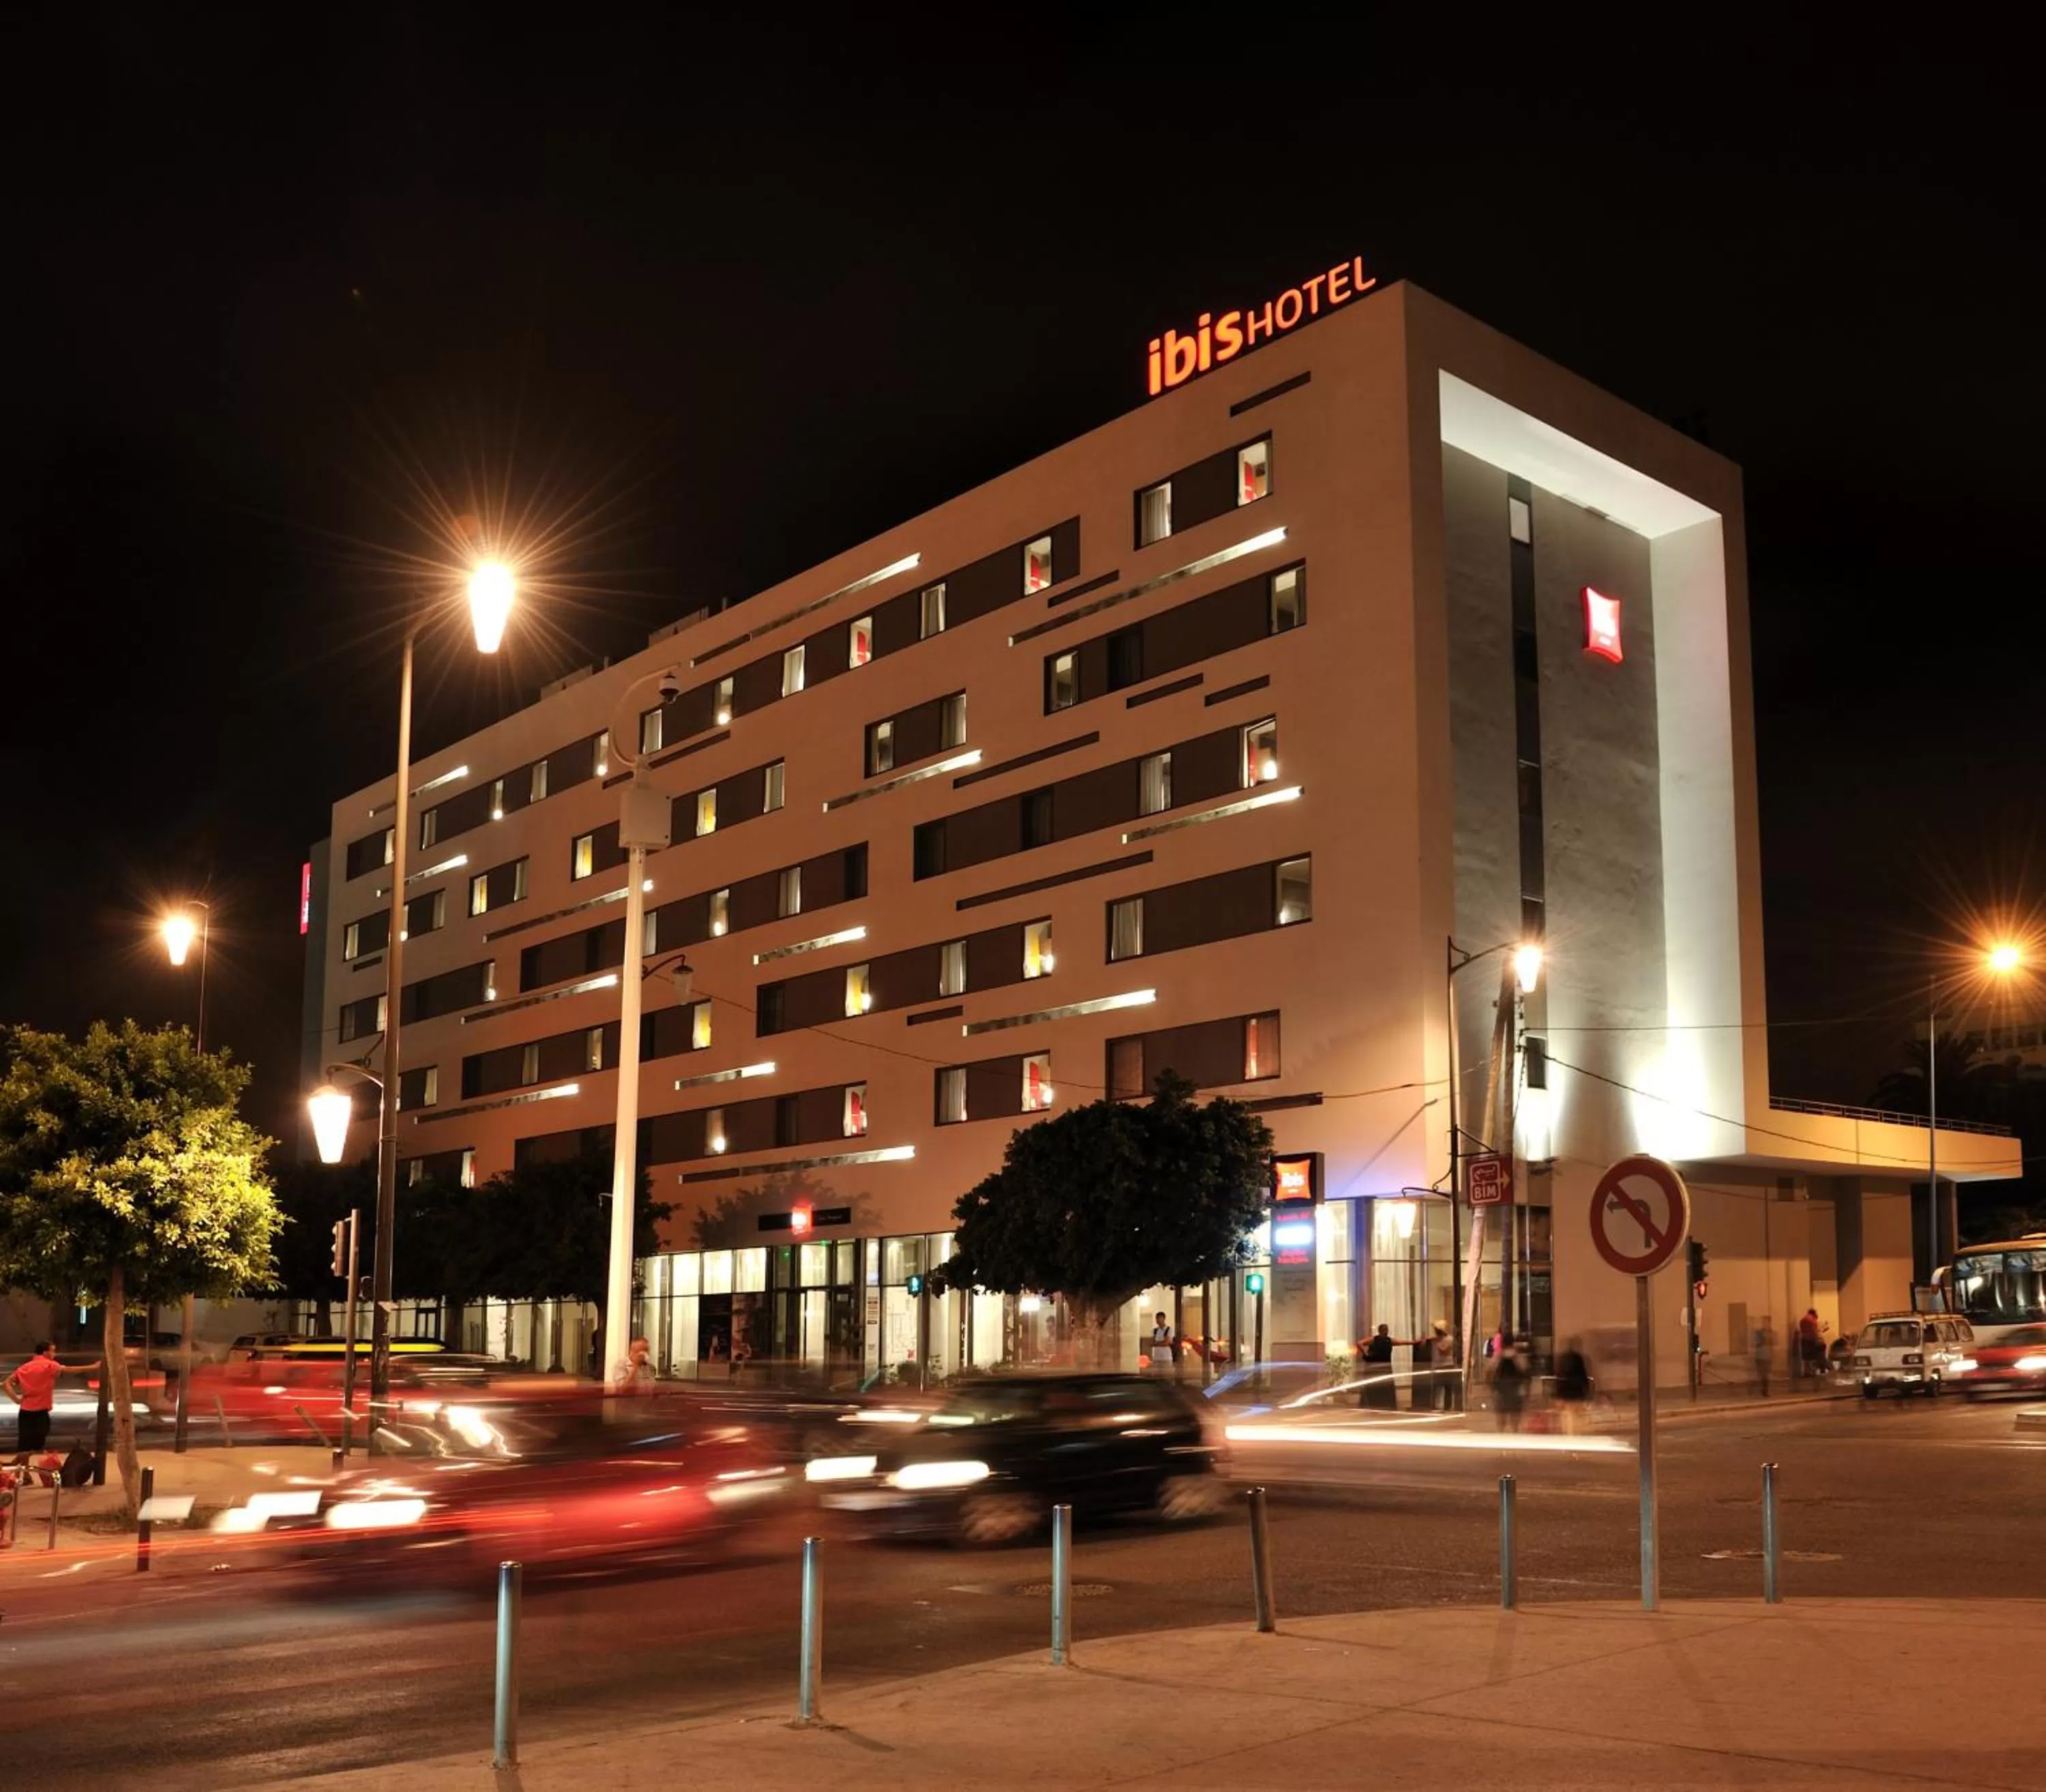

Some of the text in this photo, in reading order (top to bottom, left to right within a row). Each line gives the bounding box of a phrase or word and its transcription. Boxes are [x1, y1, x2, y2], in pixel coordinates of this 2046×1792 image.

[1148, 256, 1376, 395] ibis HOTEL
[1474, 1184, 1497, 1199] BIM
